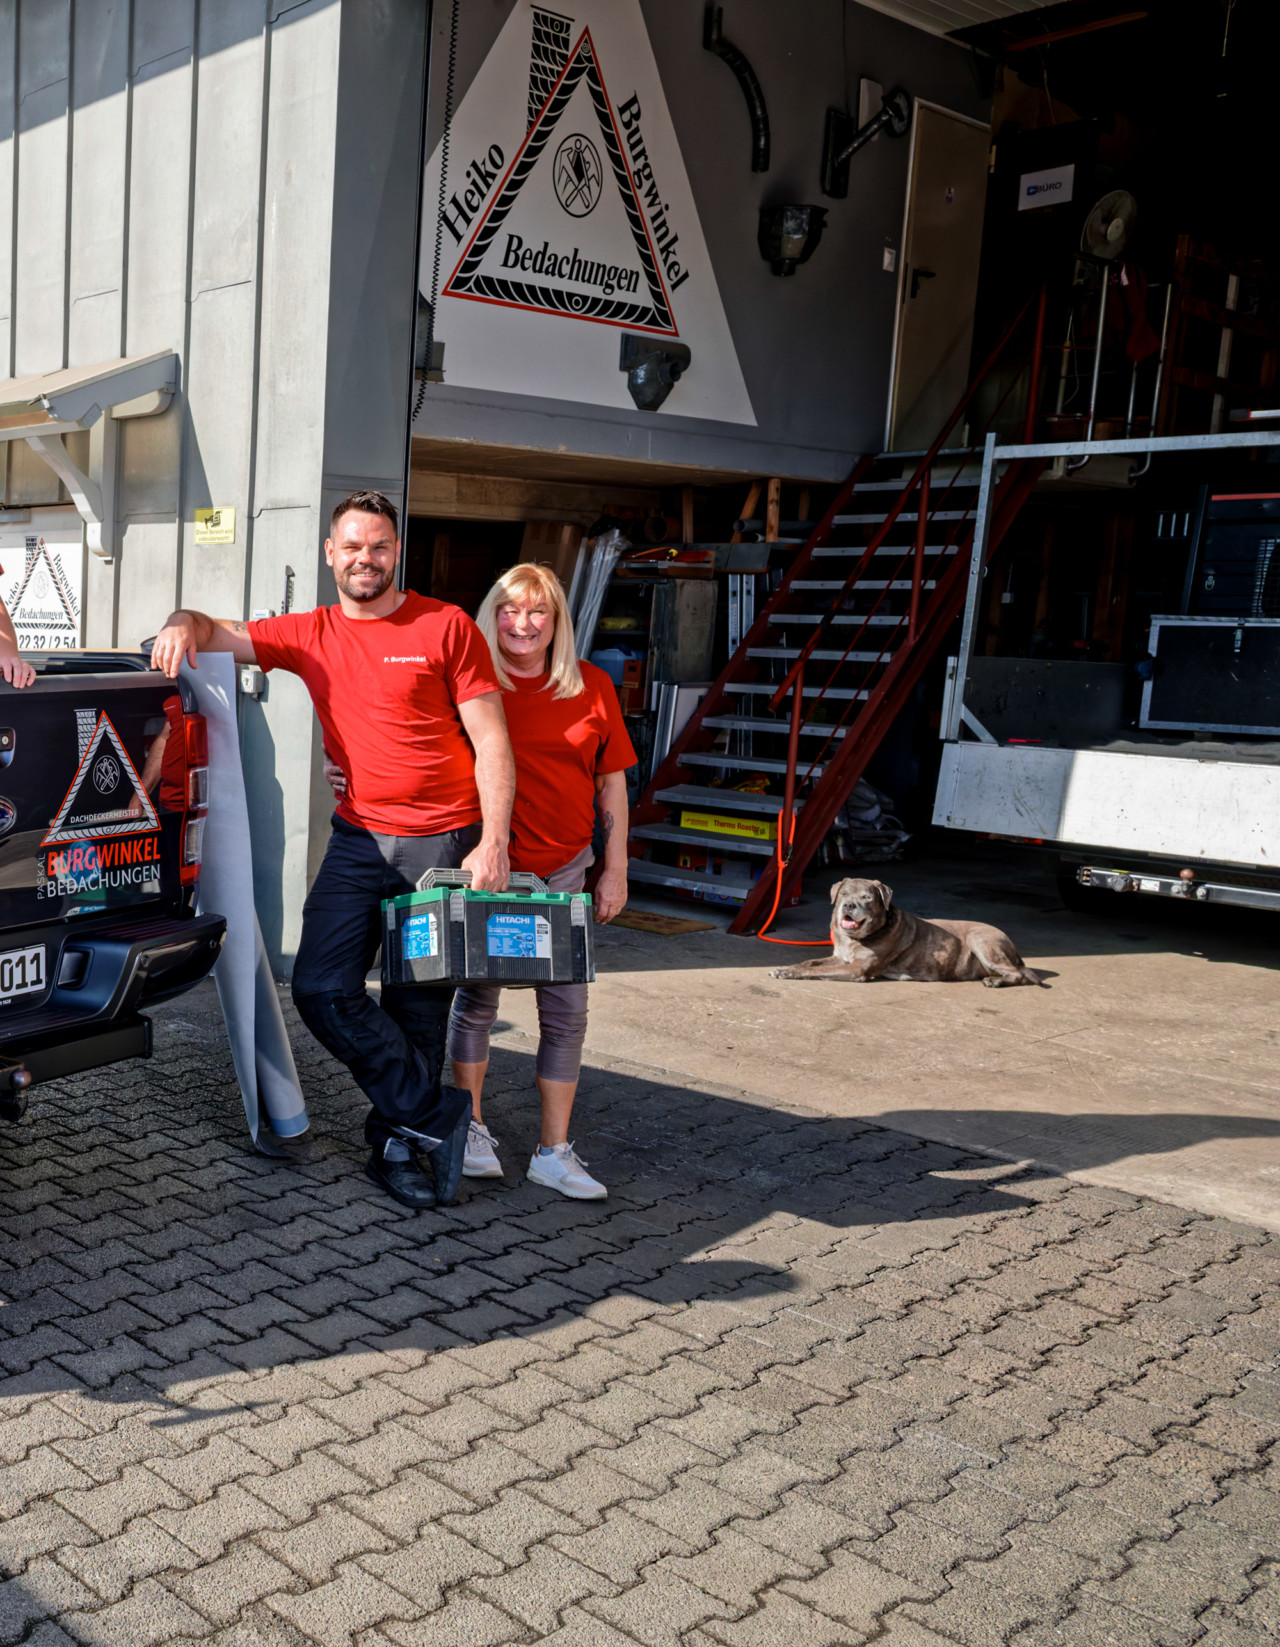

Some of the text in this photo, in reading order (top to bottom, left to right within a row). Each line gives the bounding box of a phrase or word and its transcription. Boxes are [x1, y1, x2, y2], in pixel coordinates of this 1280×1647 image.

[441, 90, 690, 294] Heiko Burgwinkel
[500, 233, 640, 296] Bedachungen
[53, 553, 80, 616] Burgwinkel
[19, 608, 64, 621] Bedachungen
[70, 808, 139, 824] DACHDECKERMEISTER
[714, 819, 736, 829] Thermo
[47, 837, 161, 876] BURGWINKEL
[37, 852, 46, 900] PASKAL
[47, 863, 160, 898] BEDACHUNGEN
[407, 916, 427, 927] HITACHI
[495, 916, 531, 925] HITACHI
